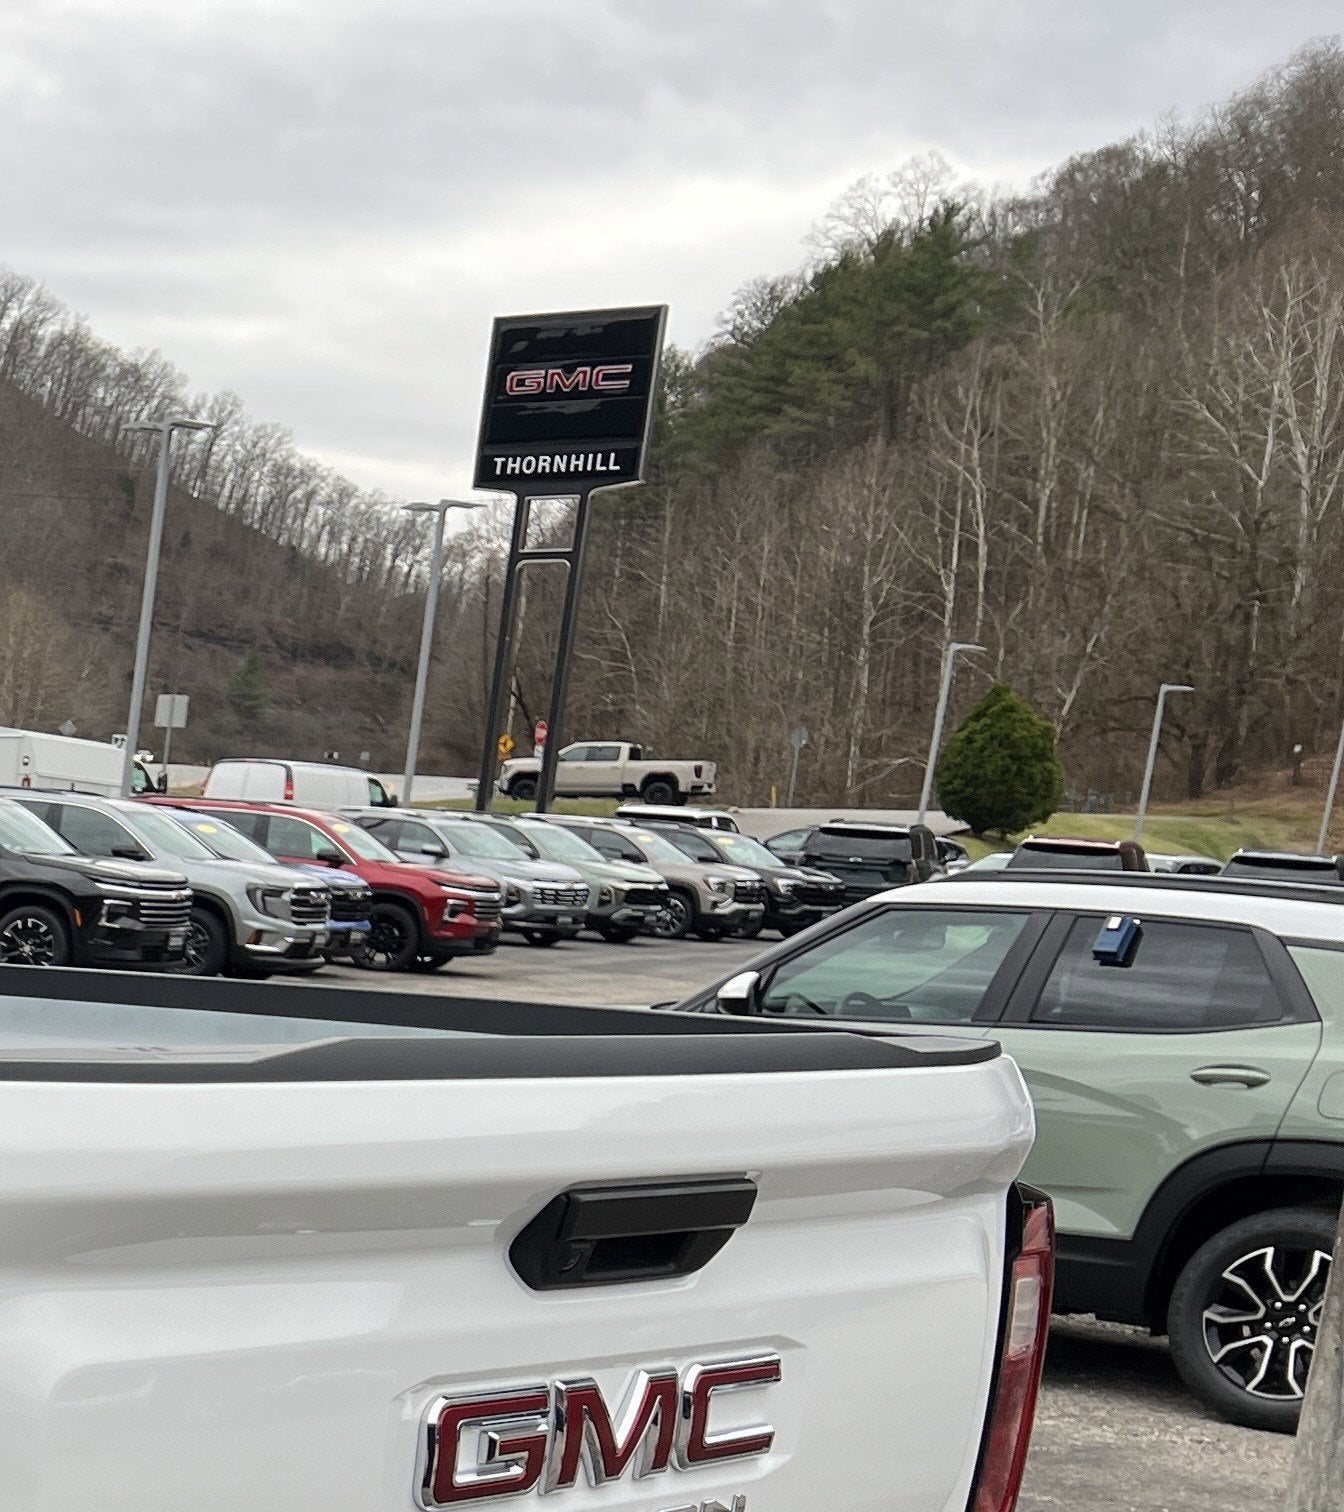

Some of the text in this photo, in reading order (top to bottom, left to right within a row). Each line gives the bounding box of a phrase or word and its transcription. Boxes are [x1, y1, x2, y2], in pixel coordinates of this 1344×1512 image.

[506, 364, 633, 395] GMC
[493, 452, 621, 475] THORNHILL
[412, 1351, 782, 1512] GMC
